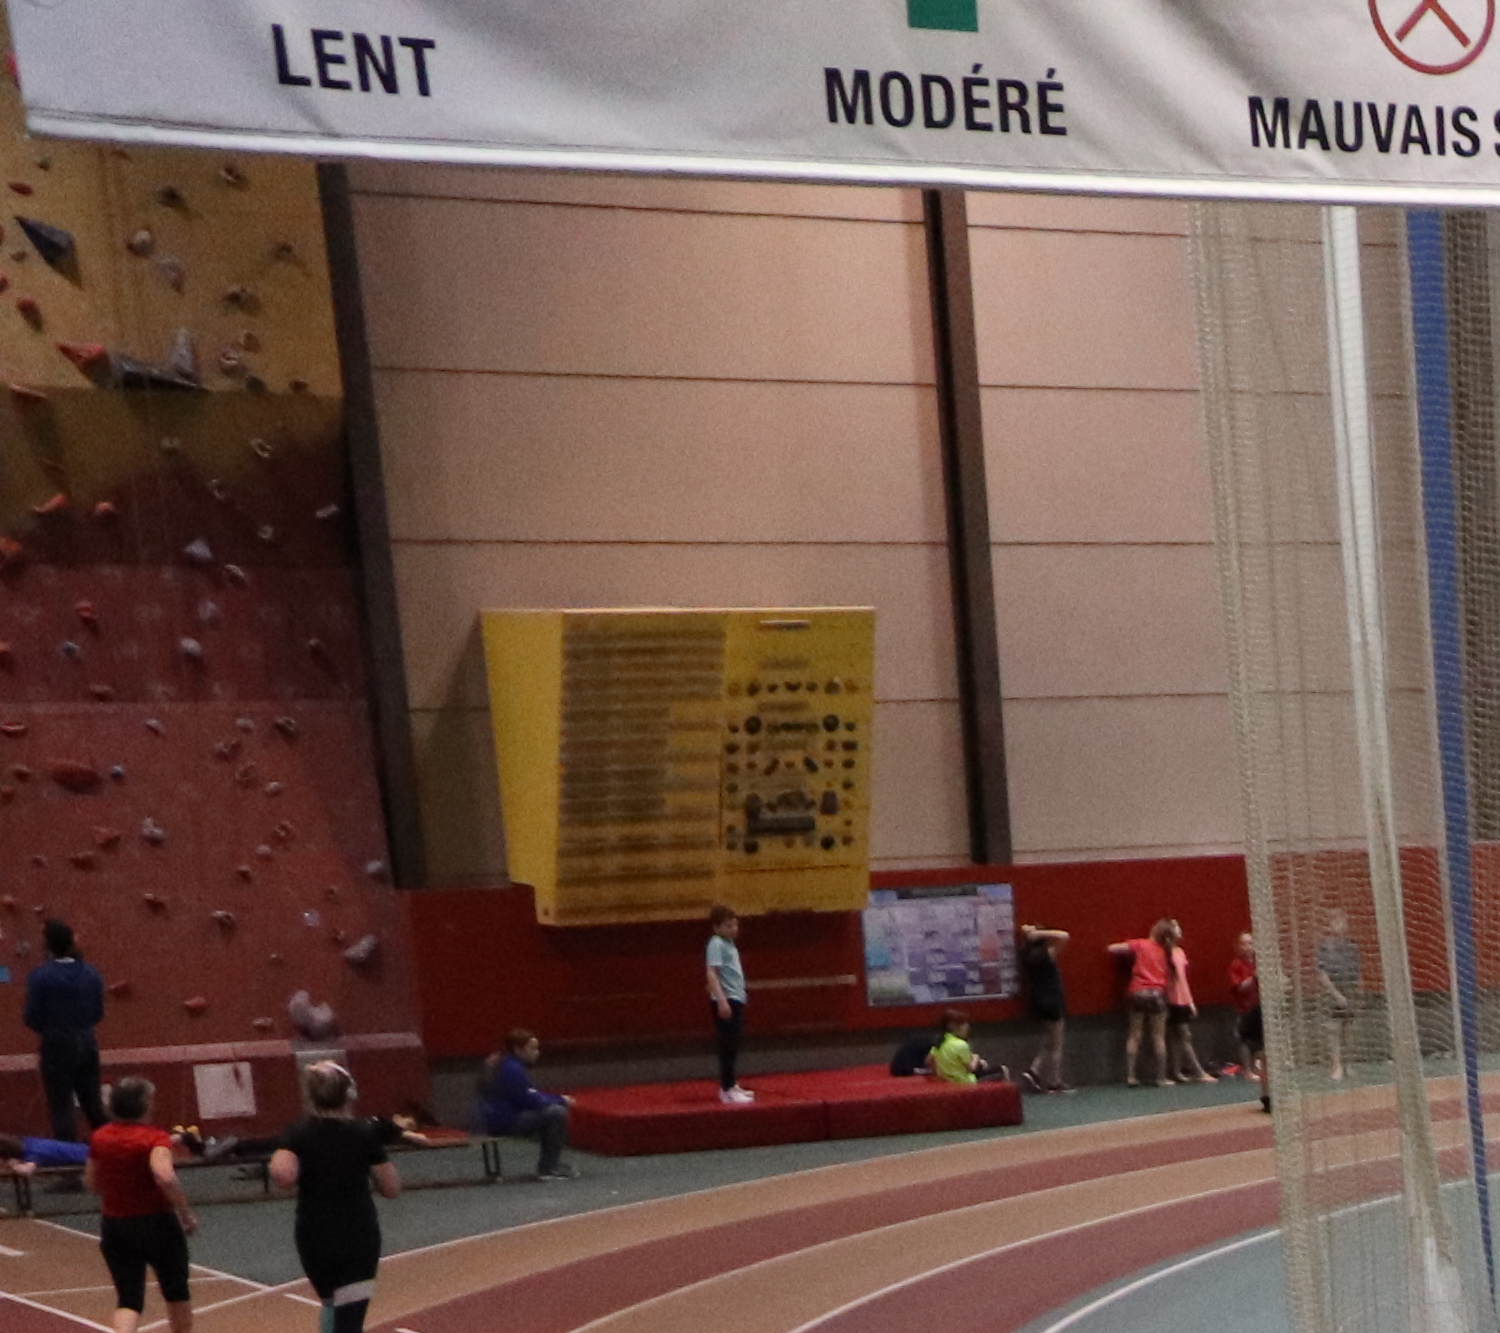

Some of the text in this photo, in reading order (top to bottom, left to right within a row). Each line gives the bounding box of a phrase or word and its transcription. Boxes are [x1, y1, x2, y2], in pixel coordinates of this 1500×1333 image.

[271, 22, 437, 97] LENT
[823, 61, 1068, 137] MODÉRÉ
[1247, 95, 1481, 159] MAUVAIS
